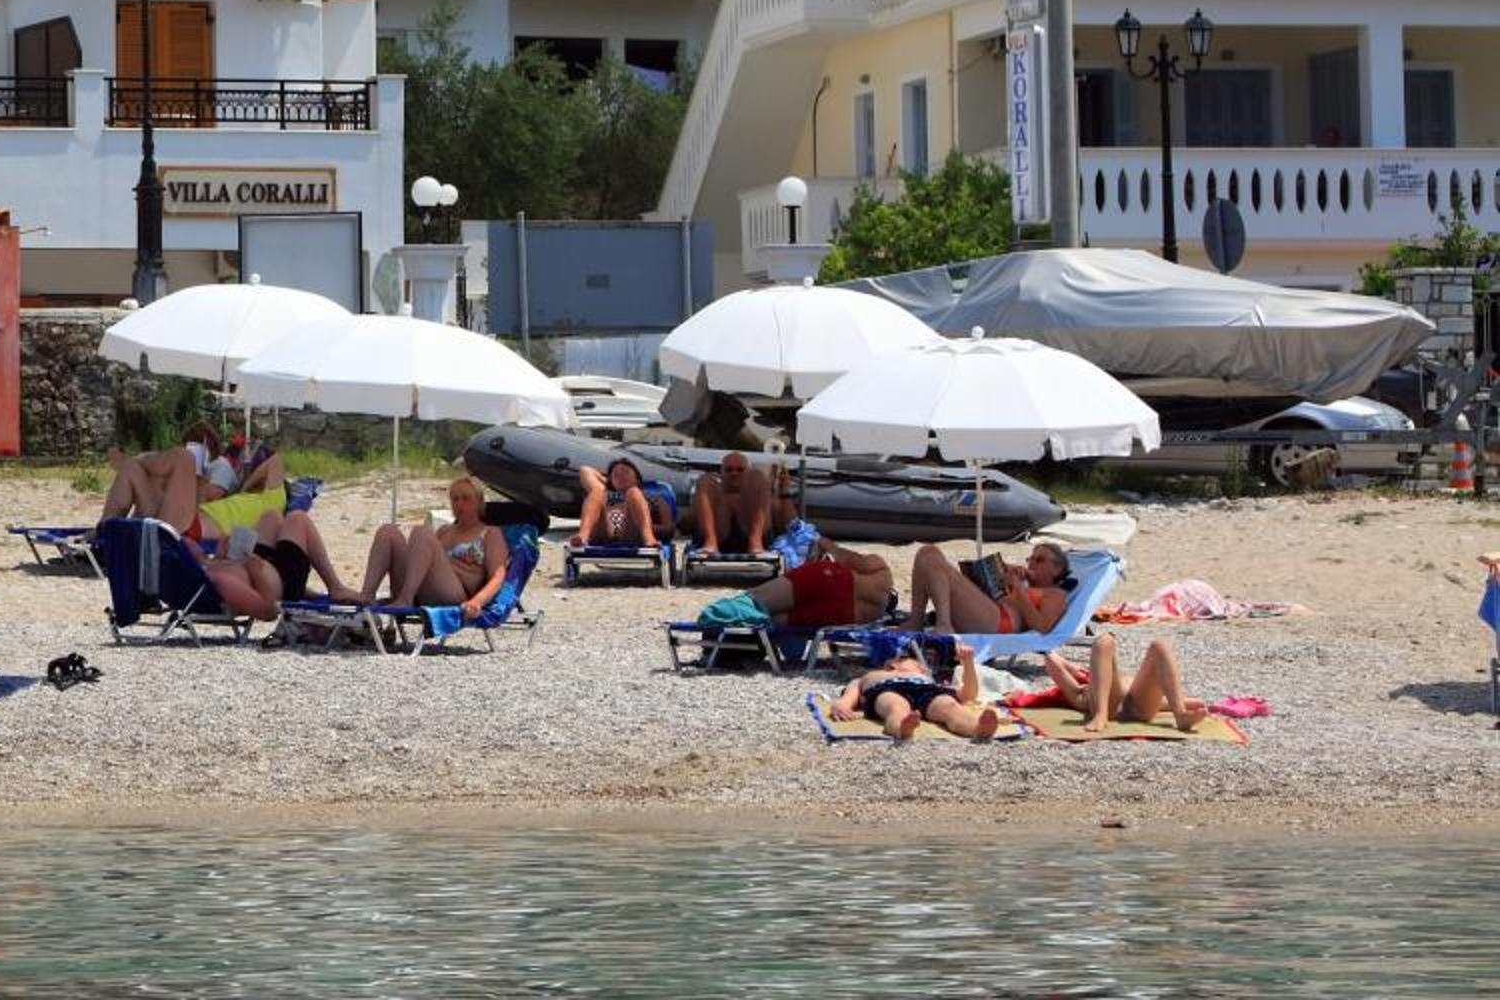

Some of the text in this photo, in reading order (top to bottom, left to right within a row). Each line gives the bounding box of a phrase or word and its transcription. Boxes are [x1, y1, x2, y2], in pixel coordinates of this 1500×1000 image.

[1013, 53, 1028, 221] KORALLI
[167, 181, 329, 205] VILLA CORALLI
